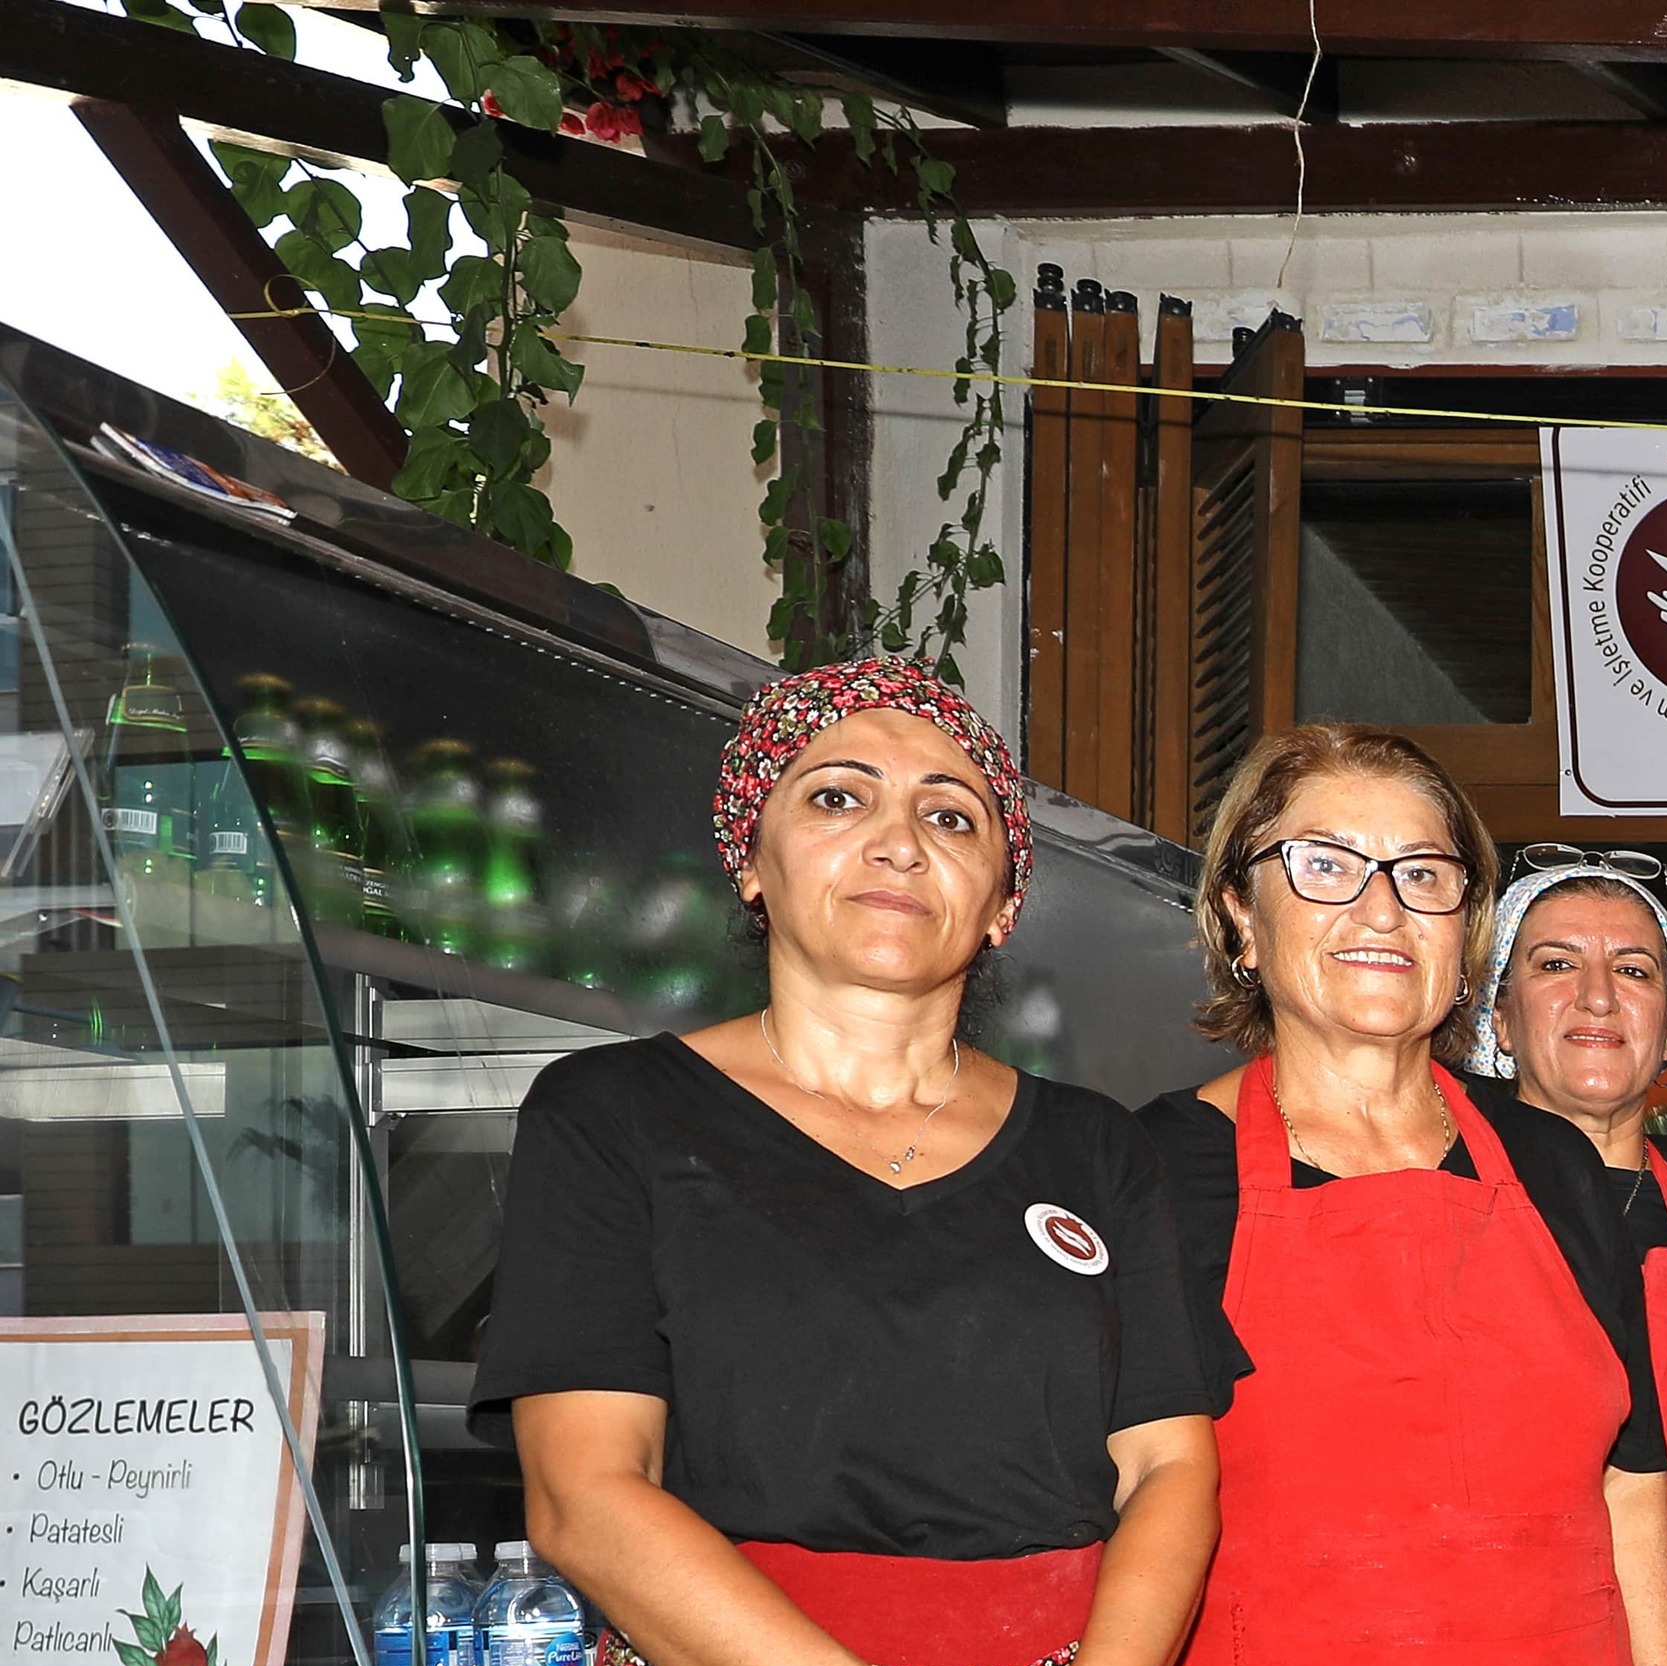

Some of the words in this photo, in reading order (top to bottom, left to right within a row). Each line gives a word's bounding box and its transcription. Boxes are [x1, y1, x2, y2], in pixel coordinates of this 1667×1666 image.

[1583, 474, 1653, 592] Kooperatifi
[1588, 600, 1633, 687] İşletme
[1630, 678, 1654, 706] ve
[18, 1395, 255, 1435] GÖZLEMELER
[37, 1460, 83, 1491] Otlu
[107, 1459, 193, 1499] Peynirli
[29, 1513, 125, 1544] Patatesli
[22, 1567, 100, 1602] Kaşarlı
[13, 1621, 113, 1652] Patlıcanlı
